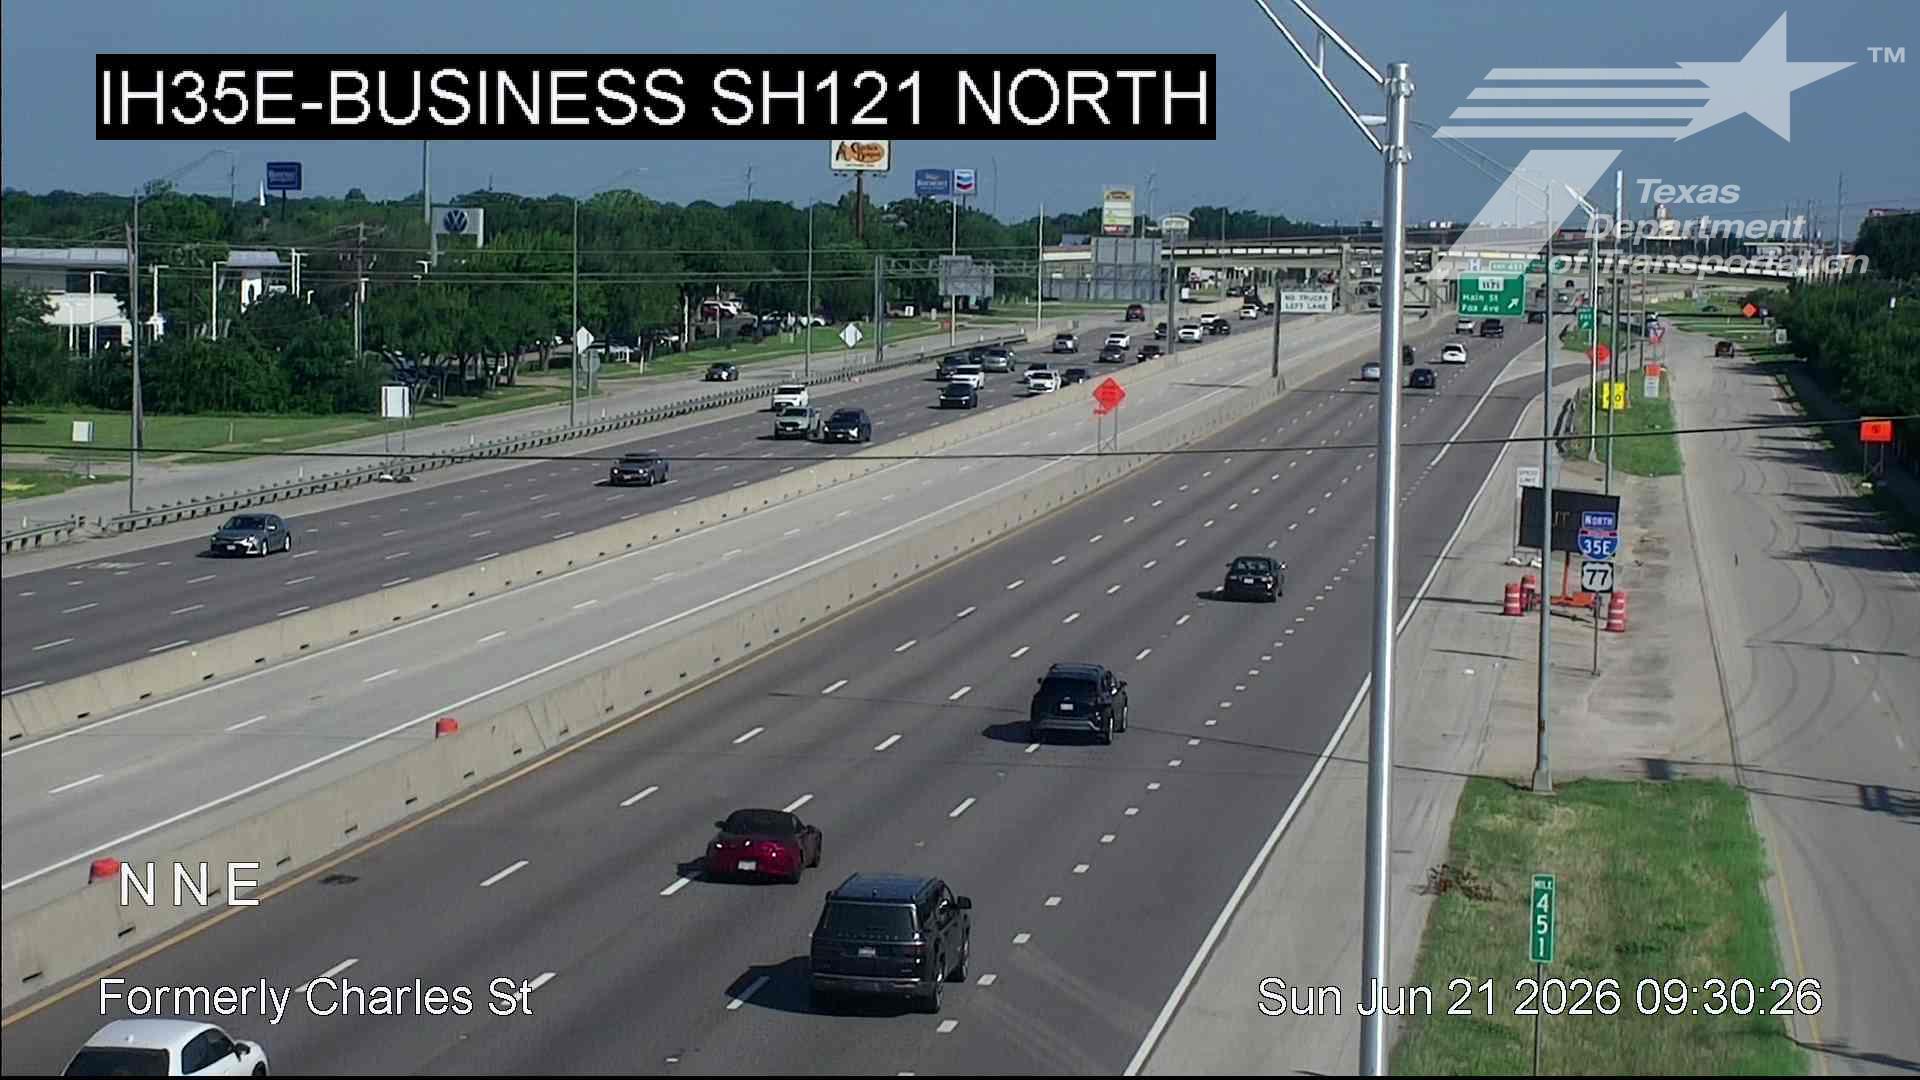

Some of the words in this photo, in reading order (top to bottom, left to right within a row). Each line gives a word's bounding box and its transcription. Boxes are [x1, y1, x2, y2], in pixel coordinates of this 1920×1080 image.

[1462, 293, 1485, 302] Main
[1489, 293, 1499, 302] St
[1461, 304, 1478, 312] Fox
[1483, 304, 1500, 312] Ave
[1584, 515, 1613, 526] NORTH
[1583, 540, 1612, 556] 35E
[1586, 569, 1609, 586] 77
[1536, 893, 1549, 957] 451
